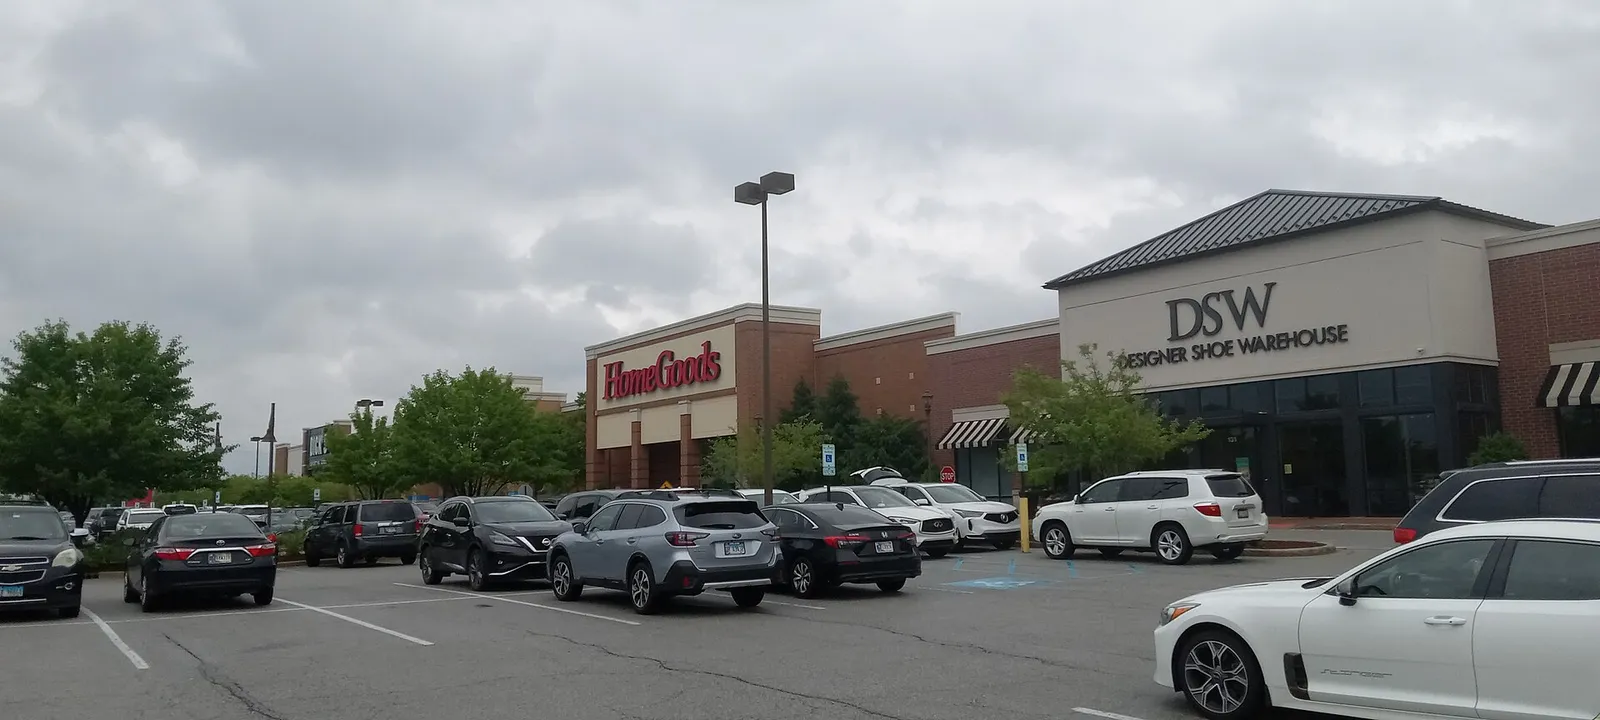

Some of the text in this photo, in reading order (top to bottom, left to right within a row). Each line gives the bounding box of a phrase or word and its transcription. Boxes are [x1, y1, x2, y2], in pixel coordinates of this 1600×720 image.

[1165, 282, 1277, 342] DSW
[1191, 341, 1234, 360] SHOE
[1237, 324, 1348, 355] WAREHOUSE
[602, 340, 721, 400] HomeGoods
[941, 472, 954, 481] STOP
